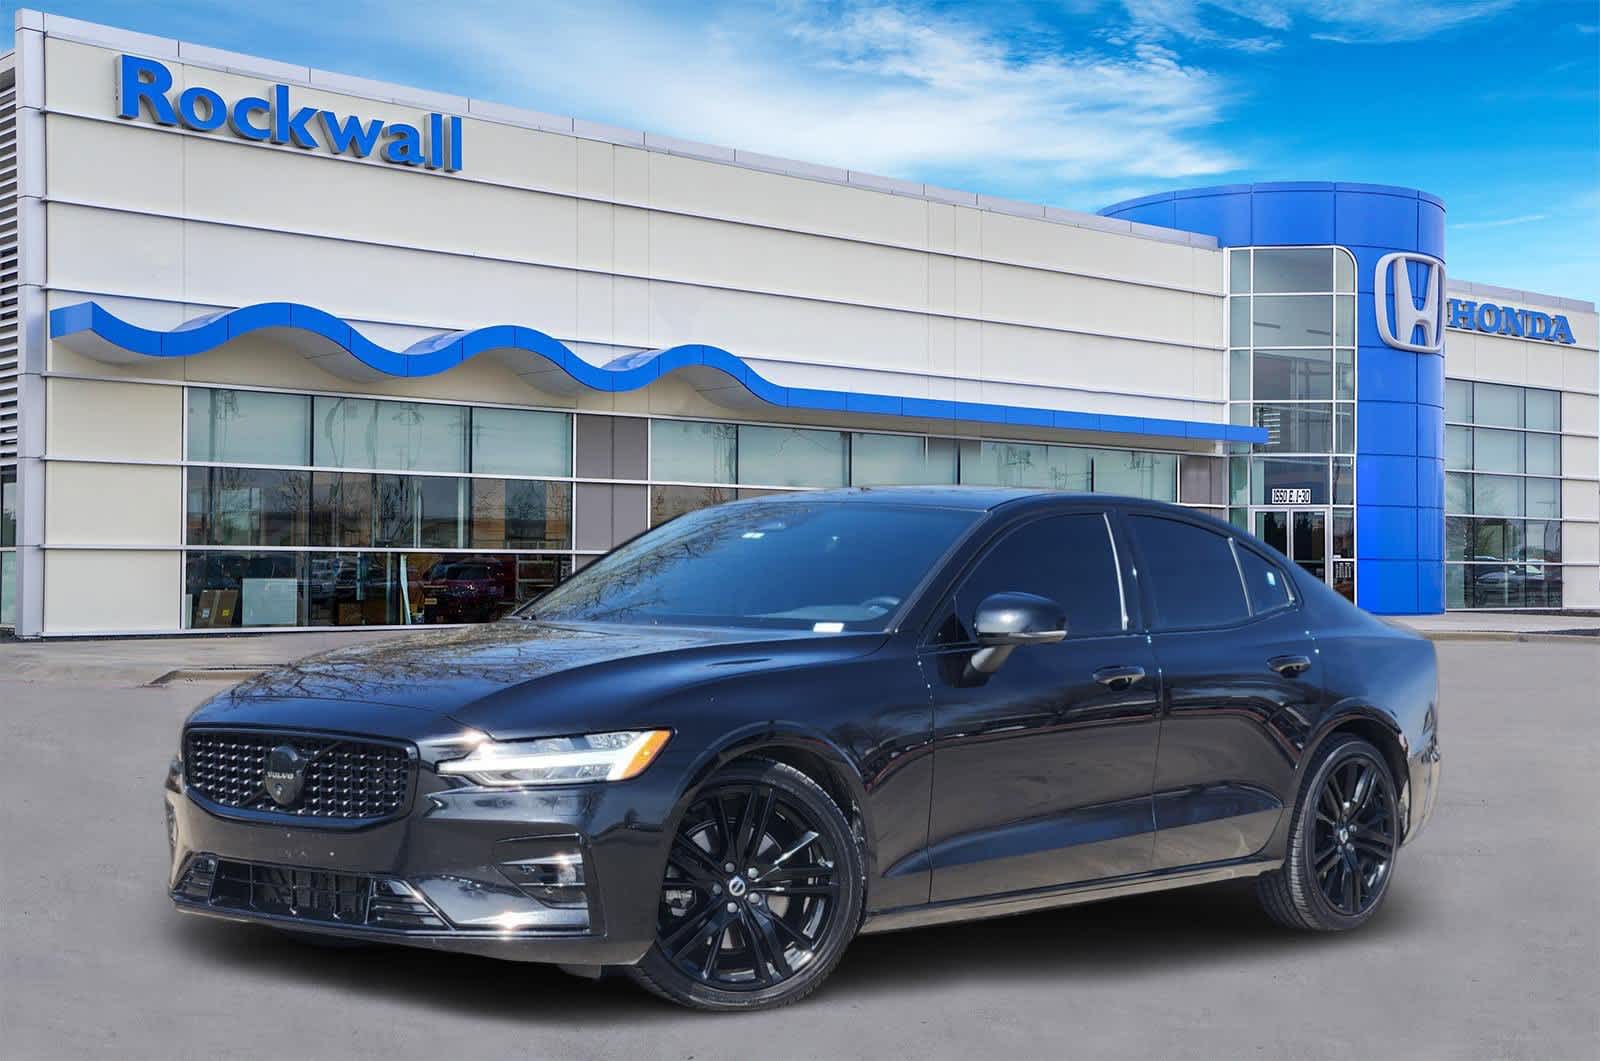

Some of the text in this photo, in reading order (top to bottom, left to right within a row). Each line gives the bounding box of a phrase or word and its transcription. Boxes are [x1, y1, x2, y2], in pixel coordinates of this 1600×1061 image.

[116, 54, 463, 173] Rockwall
[1447, 298, 1577, 345] HONDA
[267, 771, 295, 780] VOLVO
